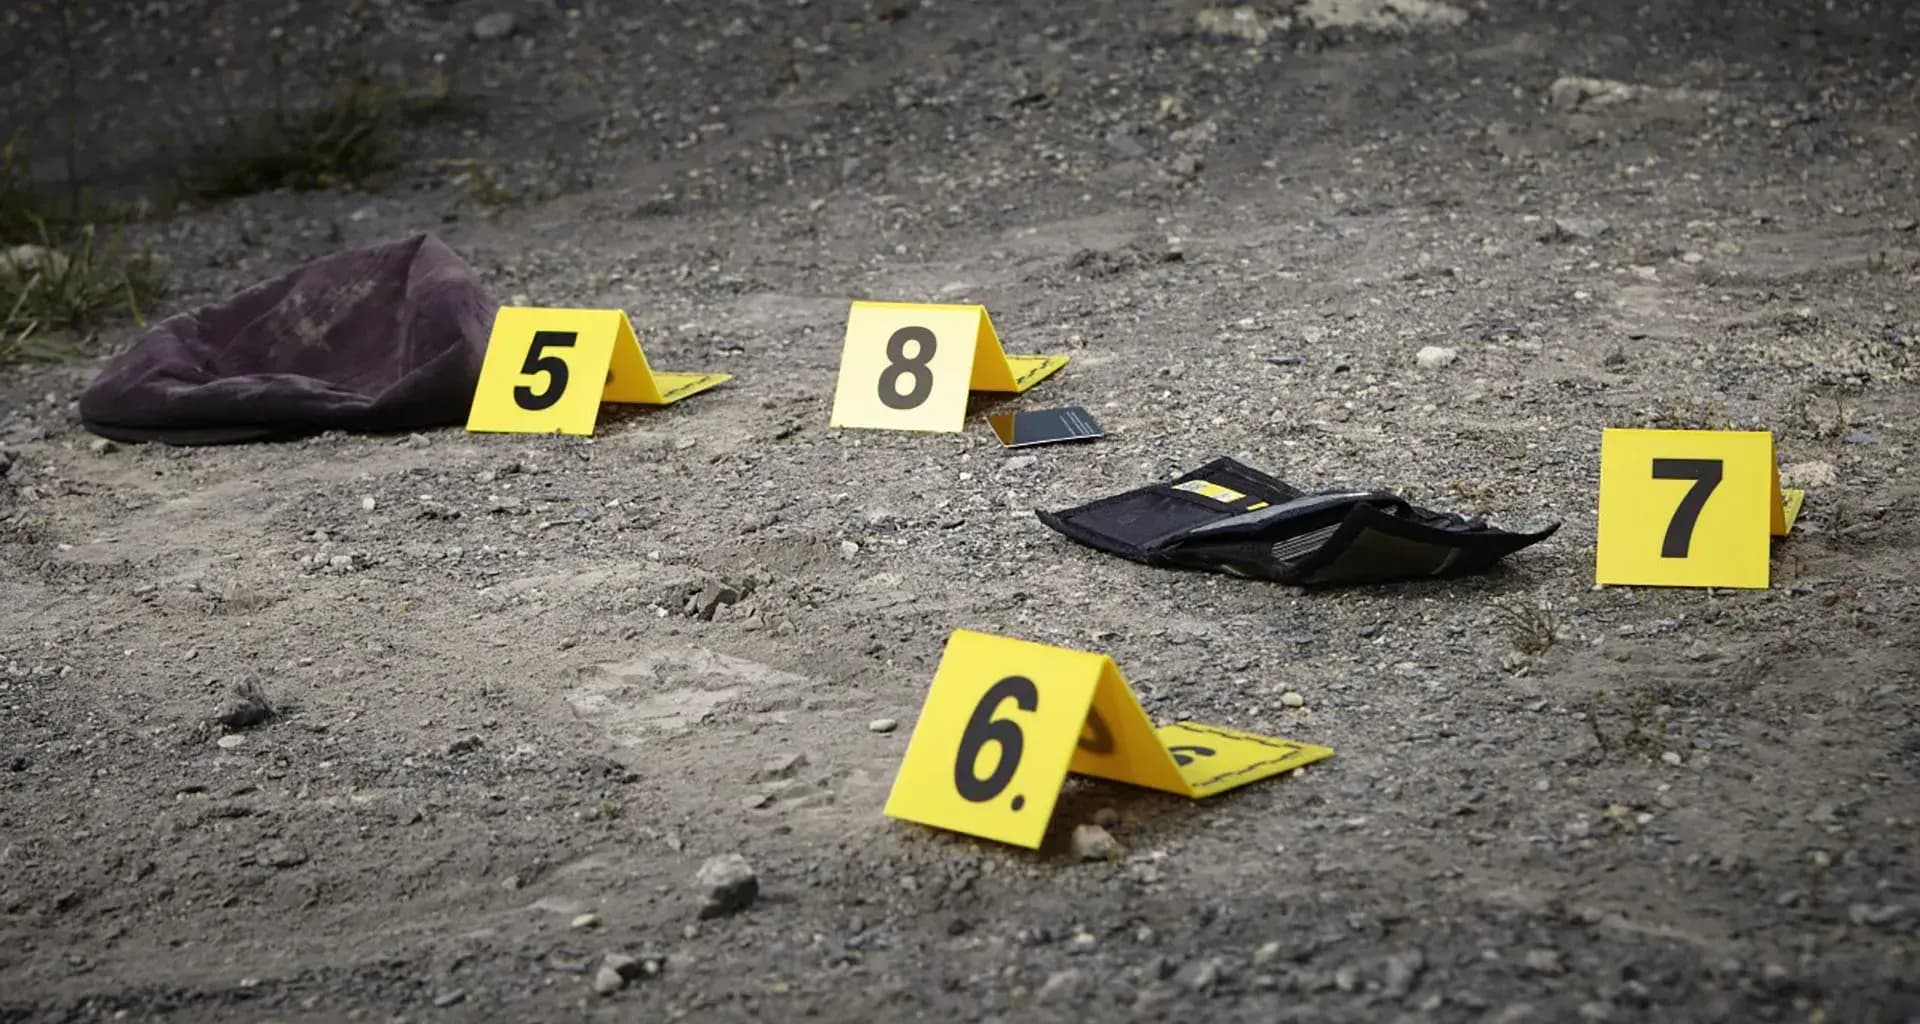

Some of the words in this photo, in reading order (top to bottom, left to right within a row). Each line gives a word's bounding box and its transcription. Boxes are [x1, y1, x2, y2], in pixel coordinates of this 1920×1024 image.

[513, 331, 578, 411] 5
[877, 326, 937, 410] 8
[1652, 458, 1723, 558] 7
[954, 675, 1039, 812] 6.
